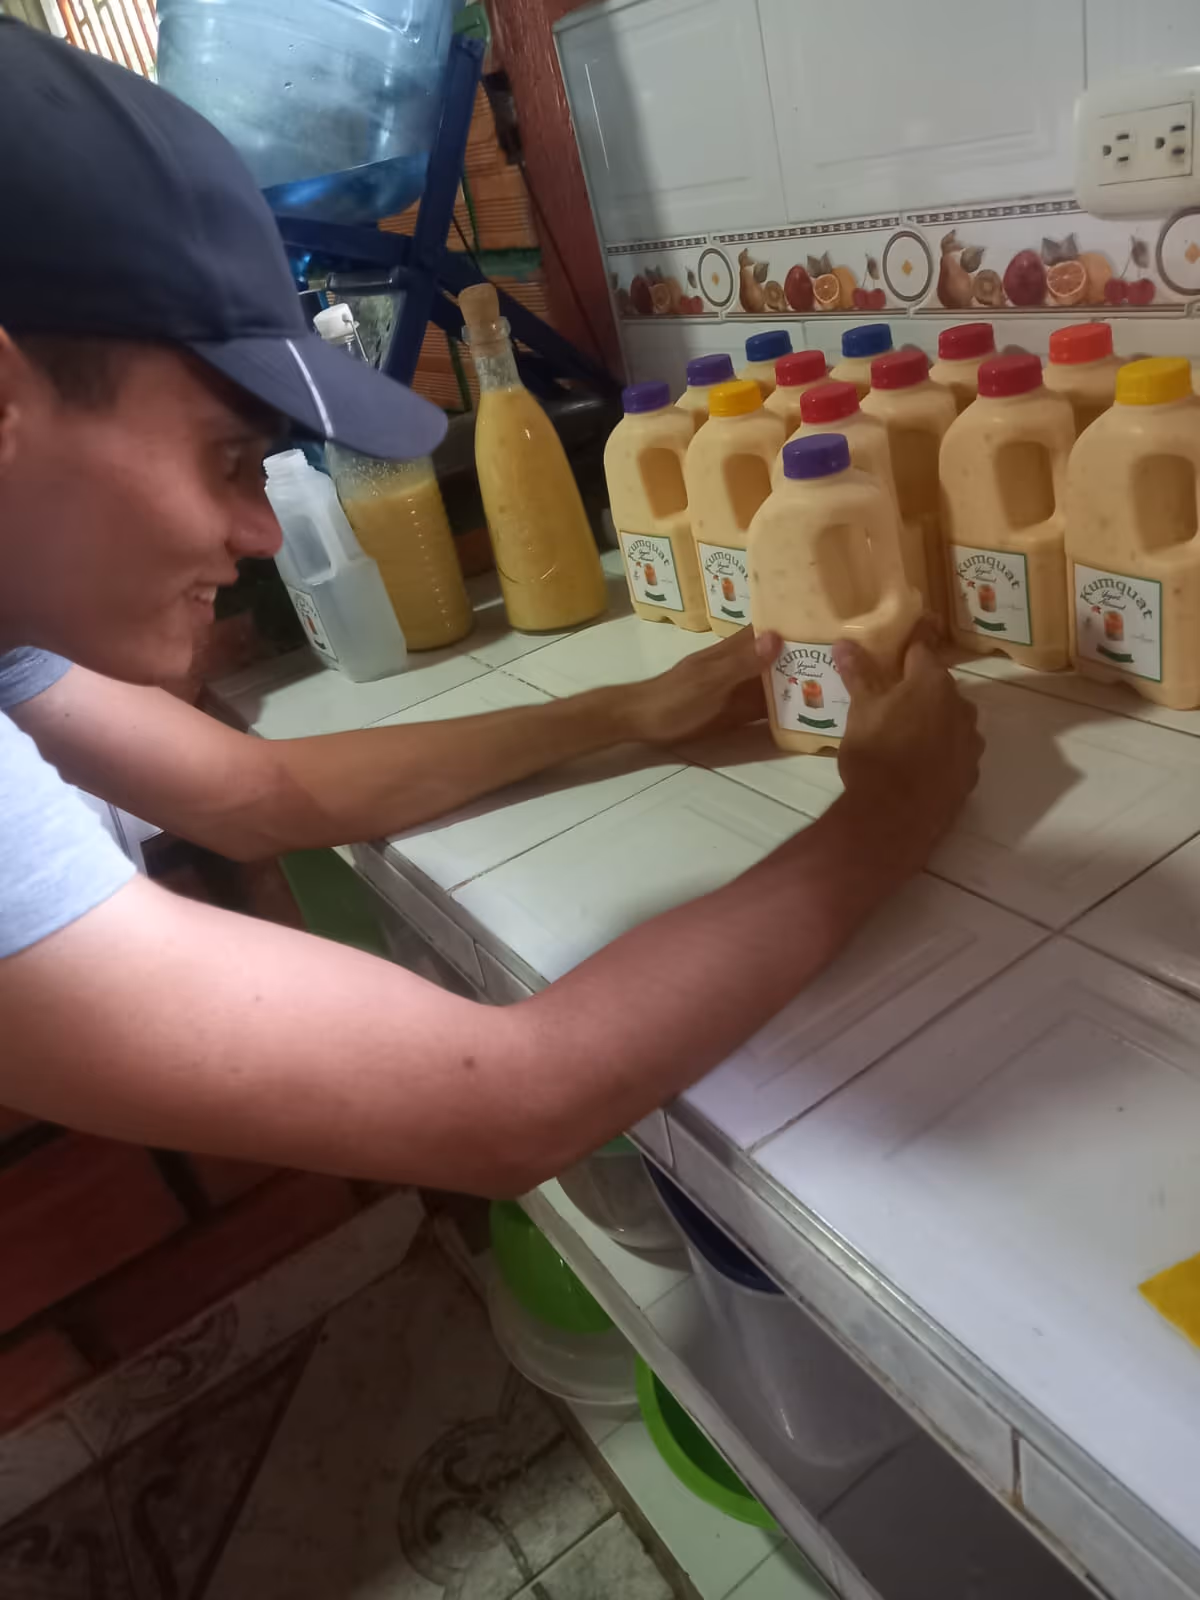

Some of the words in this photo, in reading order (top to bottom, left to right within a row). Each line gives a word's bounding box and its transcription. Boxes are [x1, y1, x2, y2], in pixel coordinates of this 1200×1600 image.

[628, 540, 670, 566] Kumquat
[956, 555, 1020, 590] Kumquat
[1080, 578, 1153, 619] Kumquat
[776, 648, 837, 677] Kumqu
